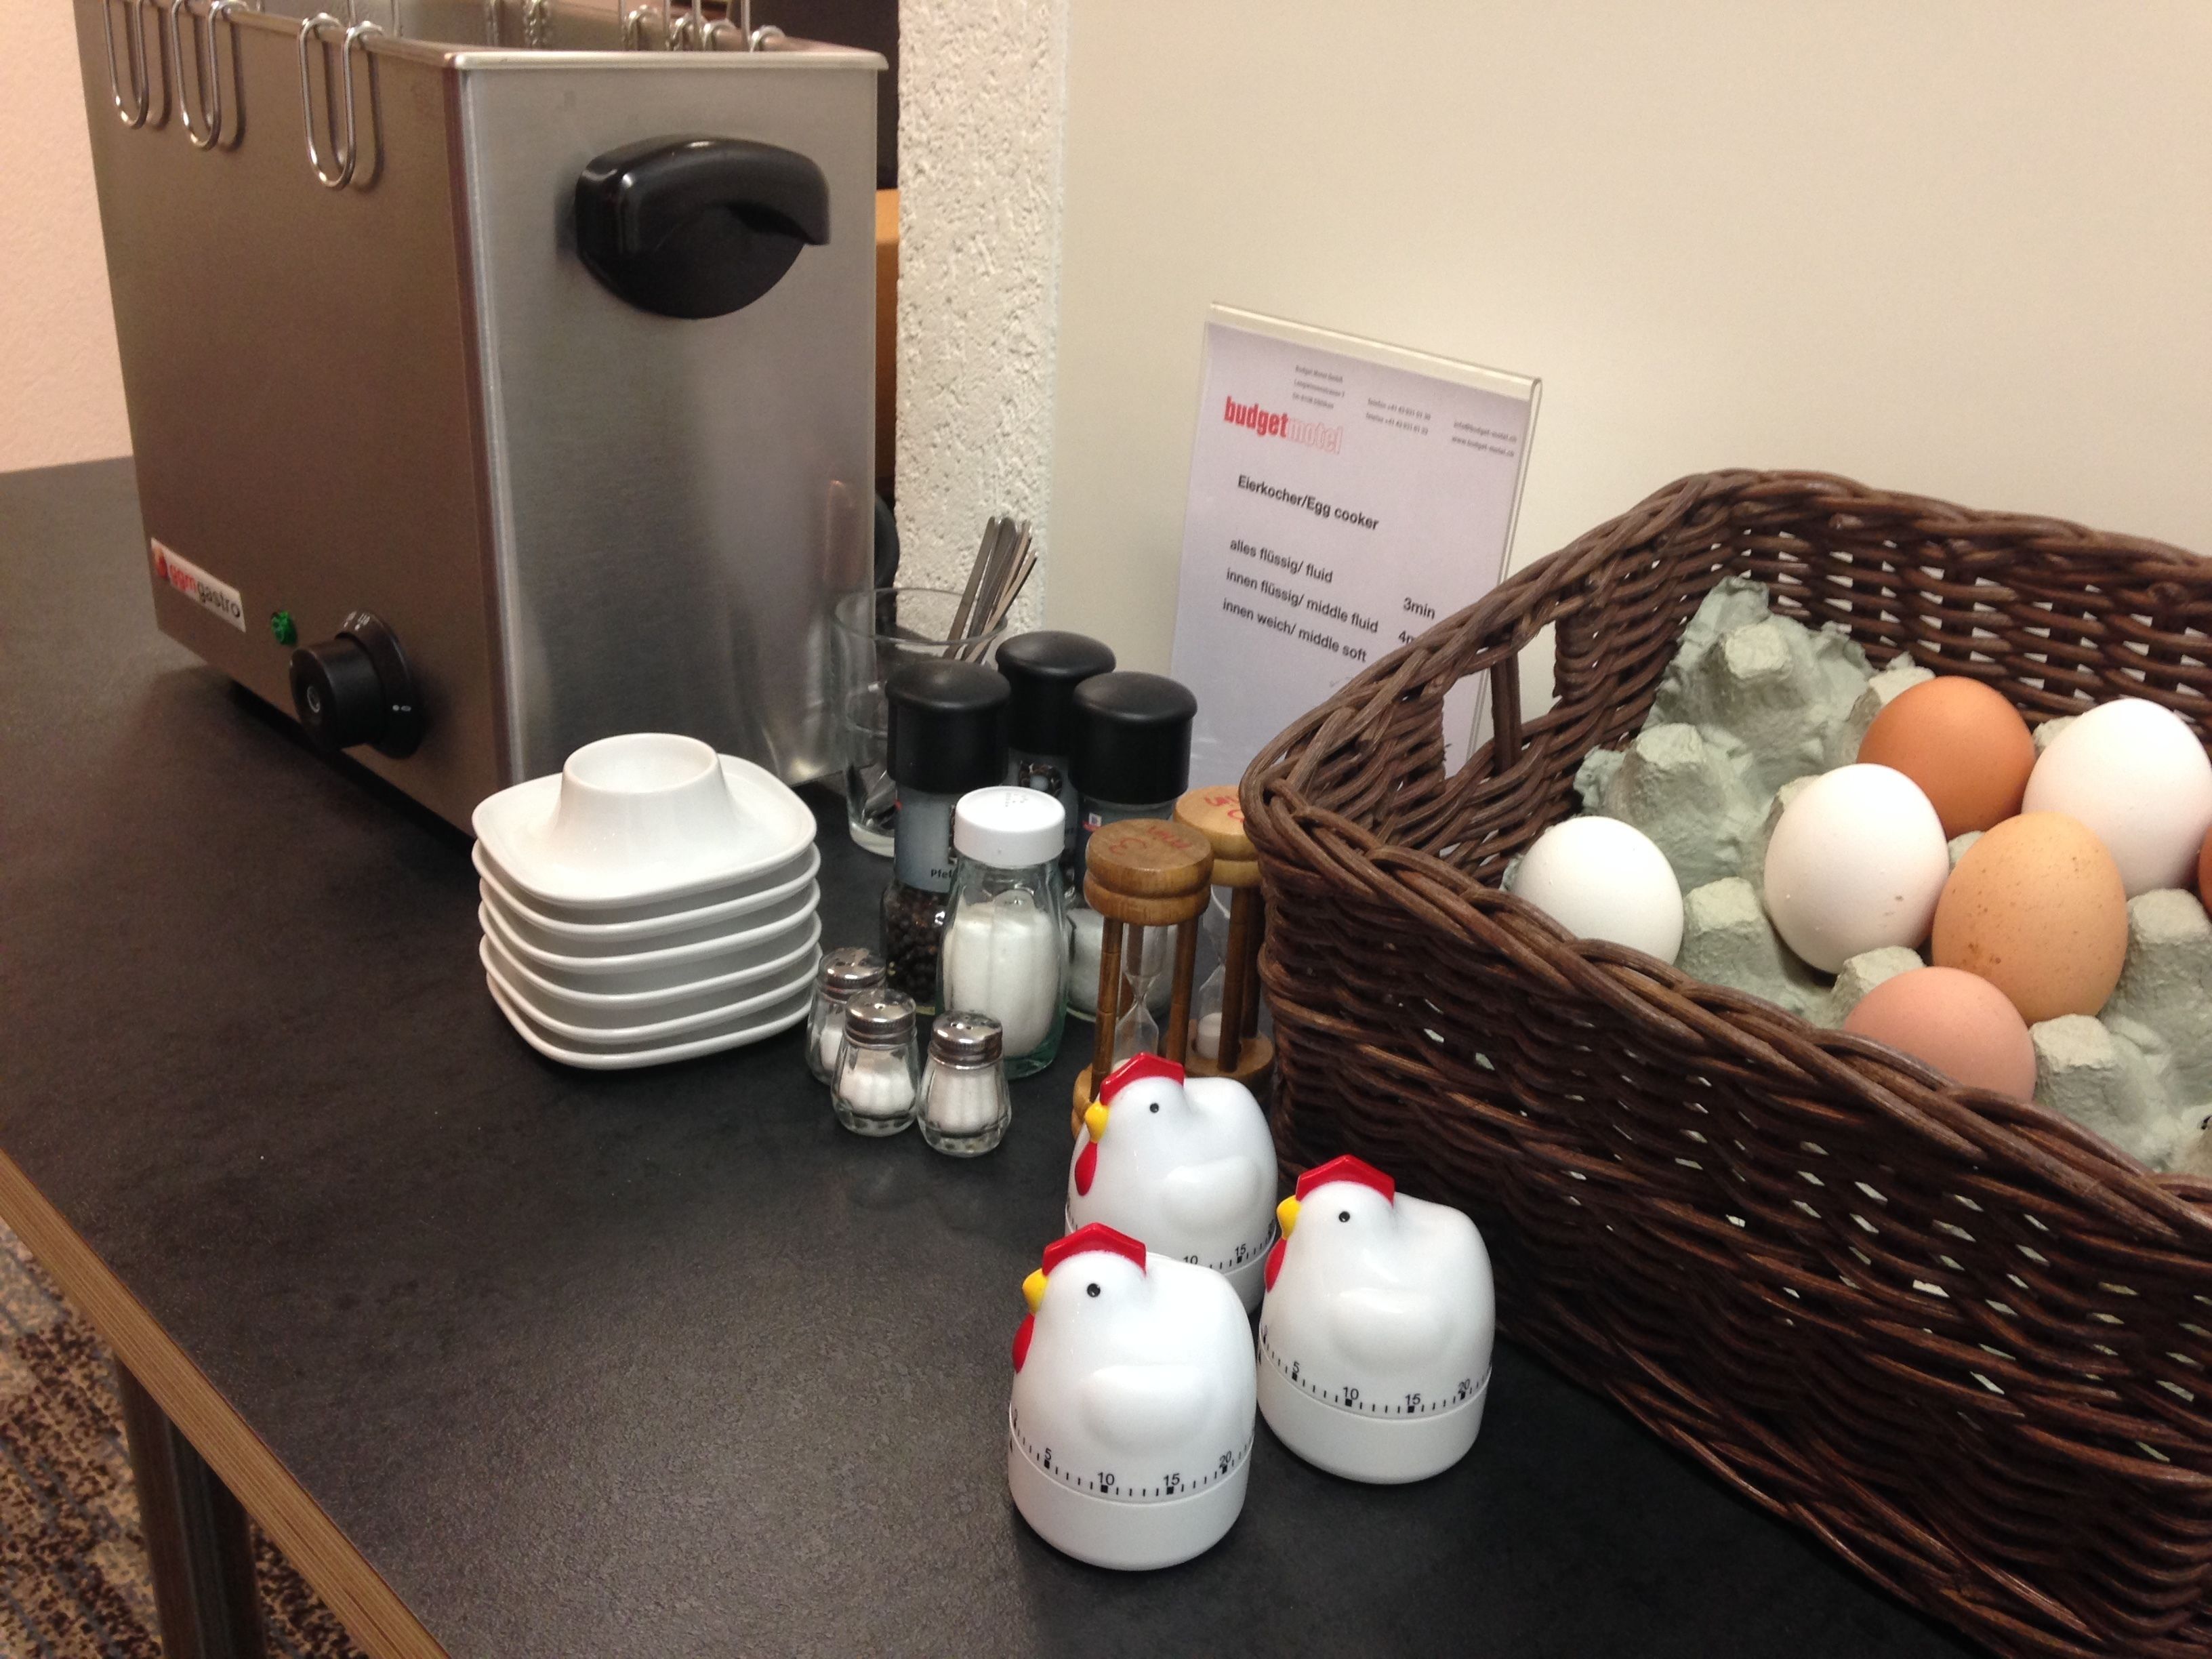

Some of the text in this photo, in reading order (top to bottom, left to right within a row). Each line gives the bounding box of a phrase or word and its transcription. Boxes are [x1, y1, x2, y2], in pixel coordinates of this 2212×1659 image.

[1237, 474, 1379, 530] Eierkocher/Egg cooker
[1230, 539, 1334, 583] alles flüssig/ fluid
[1226, 567, 1379, 633] innen flüssig/ middle fluid
[1403, 596, 1436, 620] 3min
[1223, 598, 1368, 662] innen weich/ middle soft
[1235, 1244, 1246, 1256] 15
[1293, 1361, 1300, 1374] 5
[1343, 1387, 1359, 1401] 10
[1405, 1393, 1421, 1406] 15
[1044, 1448, 1052, 1460] 5
[1098, 1472, 1115, 1486] 10
[1164, 1473, 1181, 1486] 15
[1220, 1450, 1233, 1468] 20
